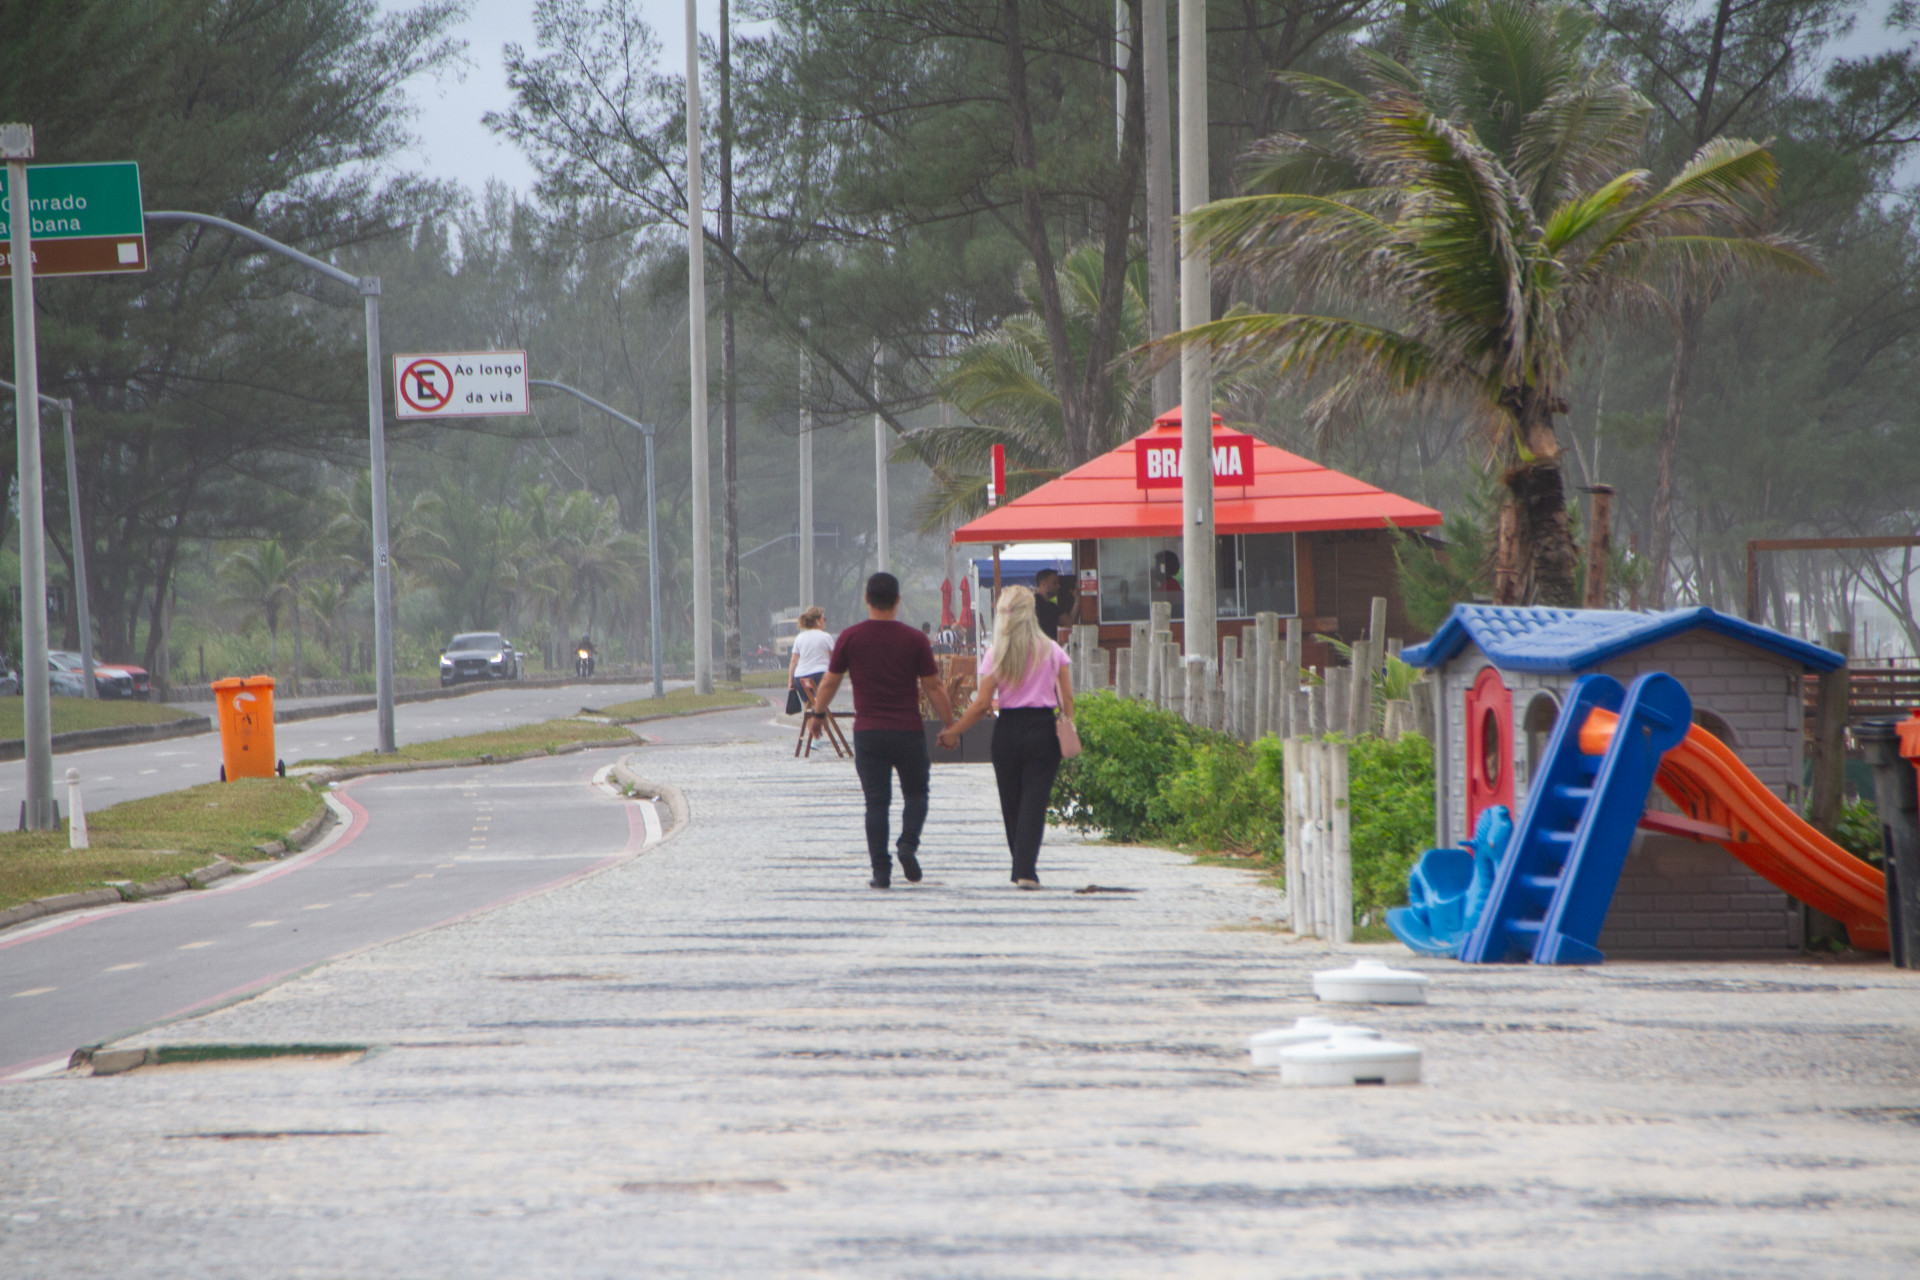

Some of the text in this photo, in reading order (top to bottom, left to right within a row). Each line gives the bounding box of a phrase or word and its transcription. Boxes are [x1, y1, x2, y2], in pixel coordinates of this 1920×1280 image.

[2, 194, 87, 213] Cnrado
[455, 363, 522, 378] Ao longo
[466, 391, 513, 404] da via
[1147, 446, 1243, 478] BRMA
